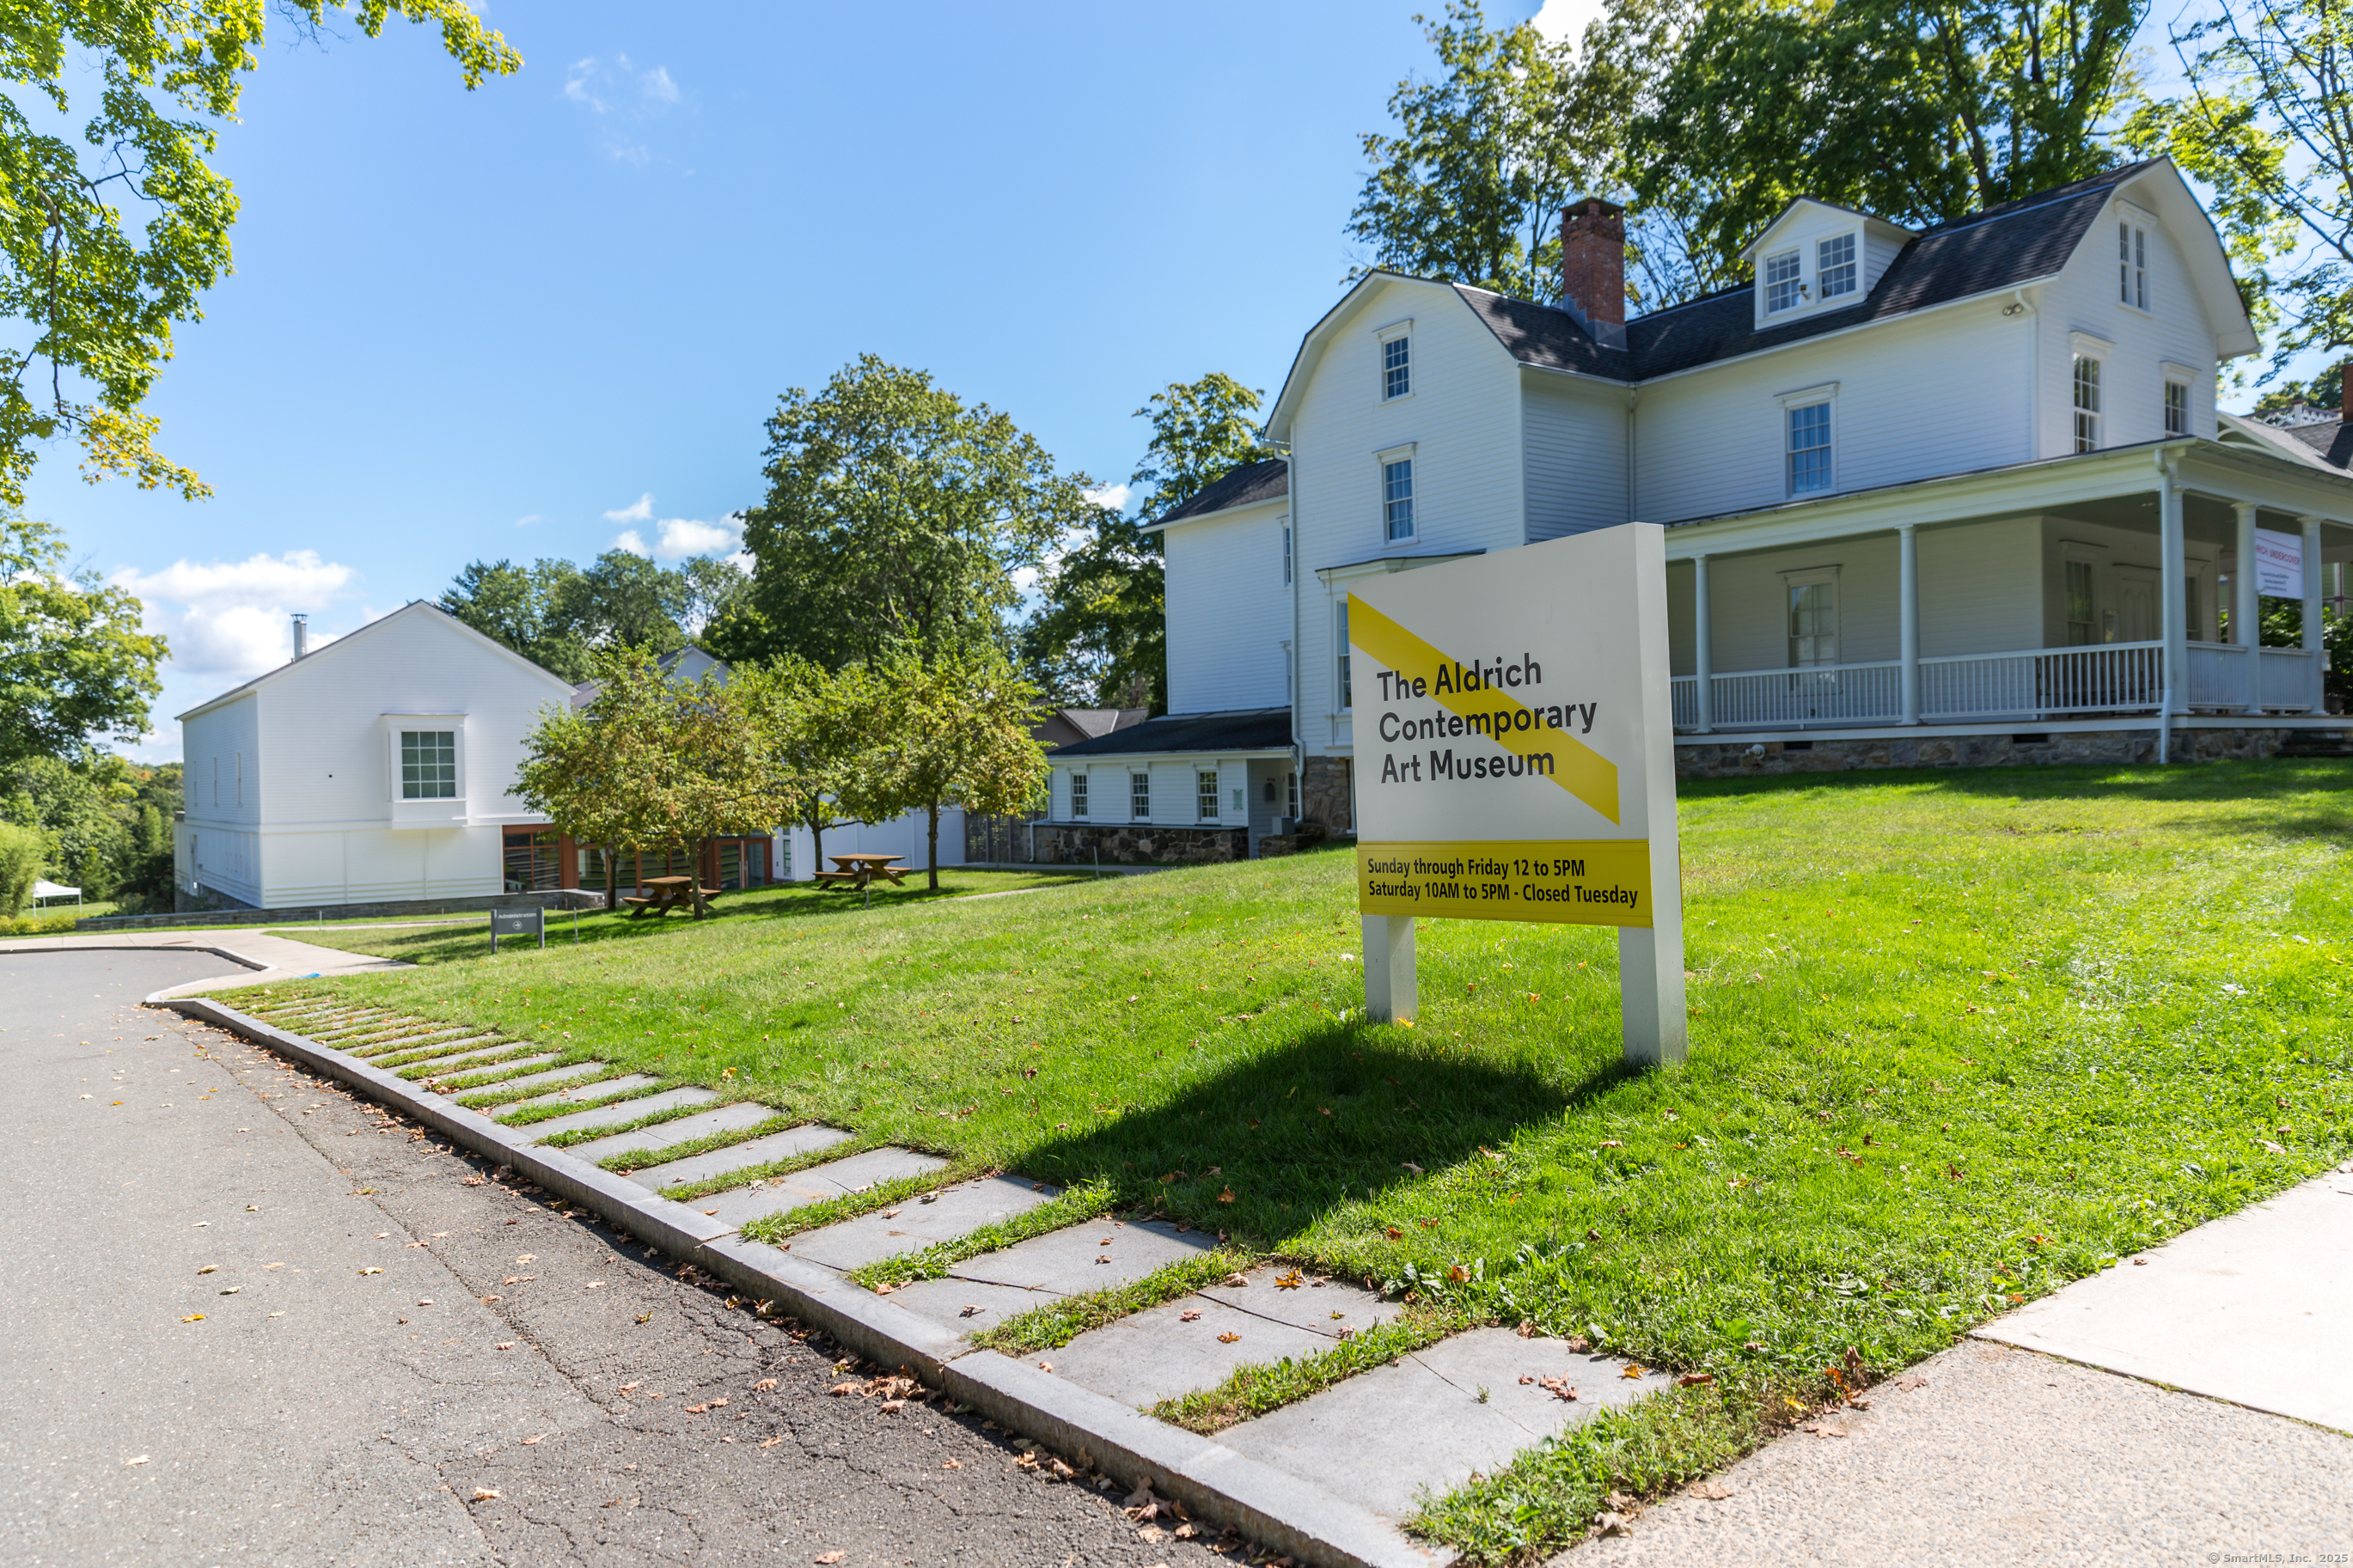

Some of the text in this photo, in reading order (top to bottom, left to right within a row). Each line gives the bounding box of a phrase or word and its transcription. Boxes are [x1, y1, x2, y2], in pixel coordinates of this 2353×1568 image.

[2270, 548, 2301, 565] UNDERCOVER
[1376, 652, 1542, 702] The Aldrich
[1378, 702, 1598, 743] Contemporary
[1381, 748, 1555, 784] Art Museum
[1367, 857, 1586, 881] Sunday through Friday 12 to 5PM
[1368, 880, 1421, 902] Saturday
[1424, 882, 1460, 899] 10AM
[1463, 883, 1478, 900] to
[1481, 882, 1511, 900] 5PM
[1522, 882, 1571, 903] Closed
[1574, 884, 1639, 909] Tuesday
